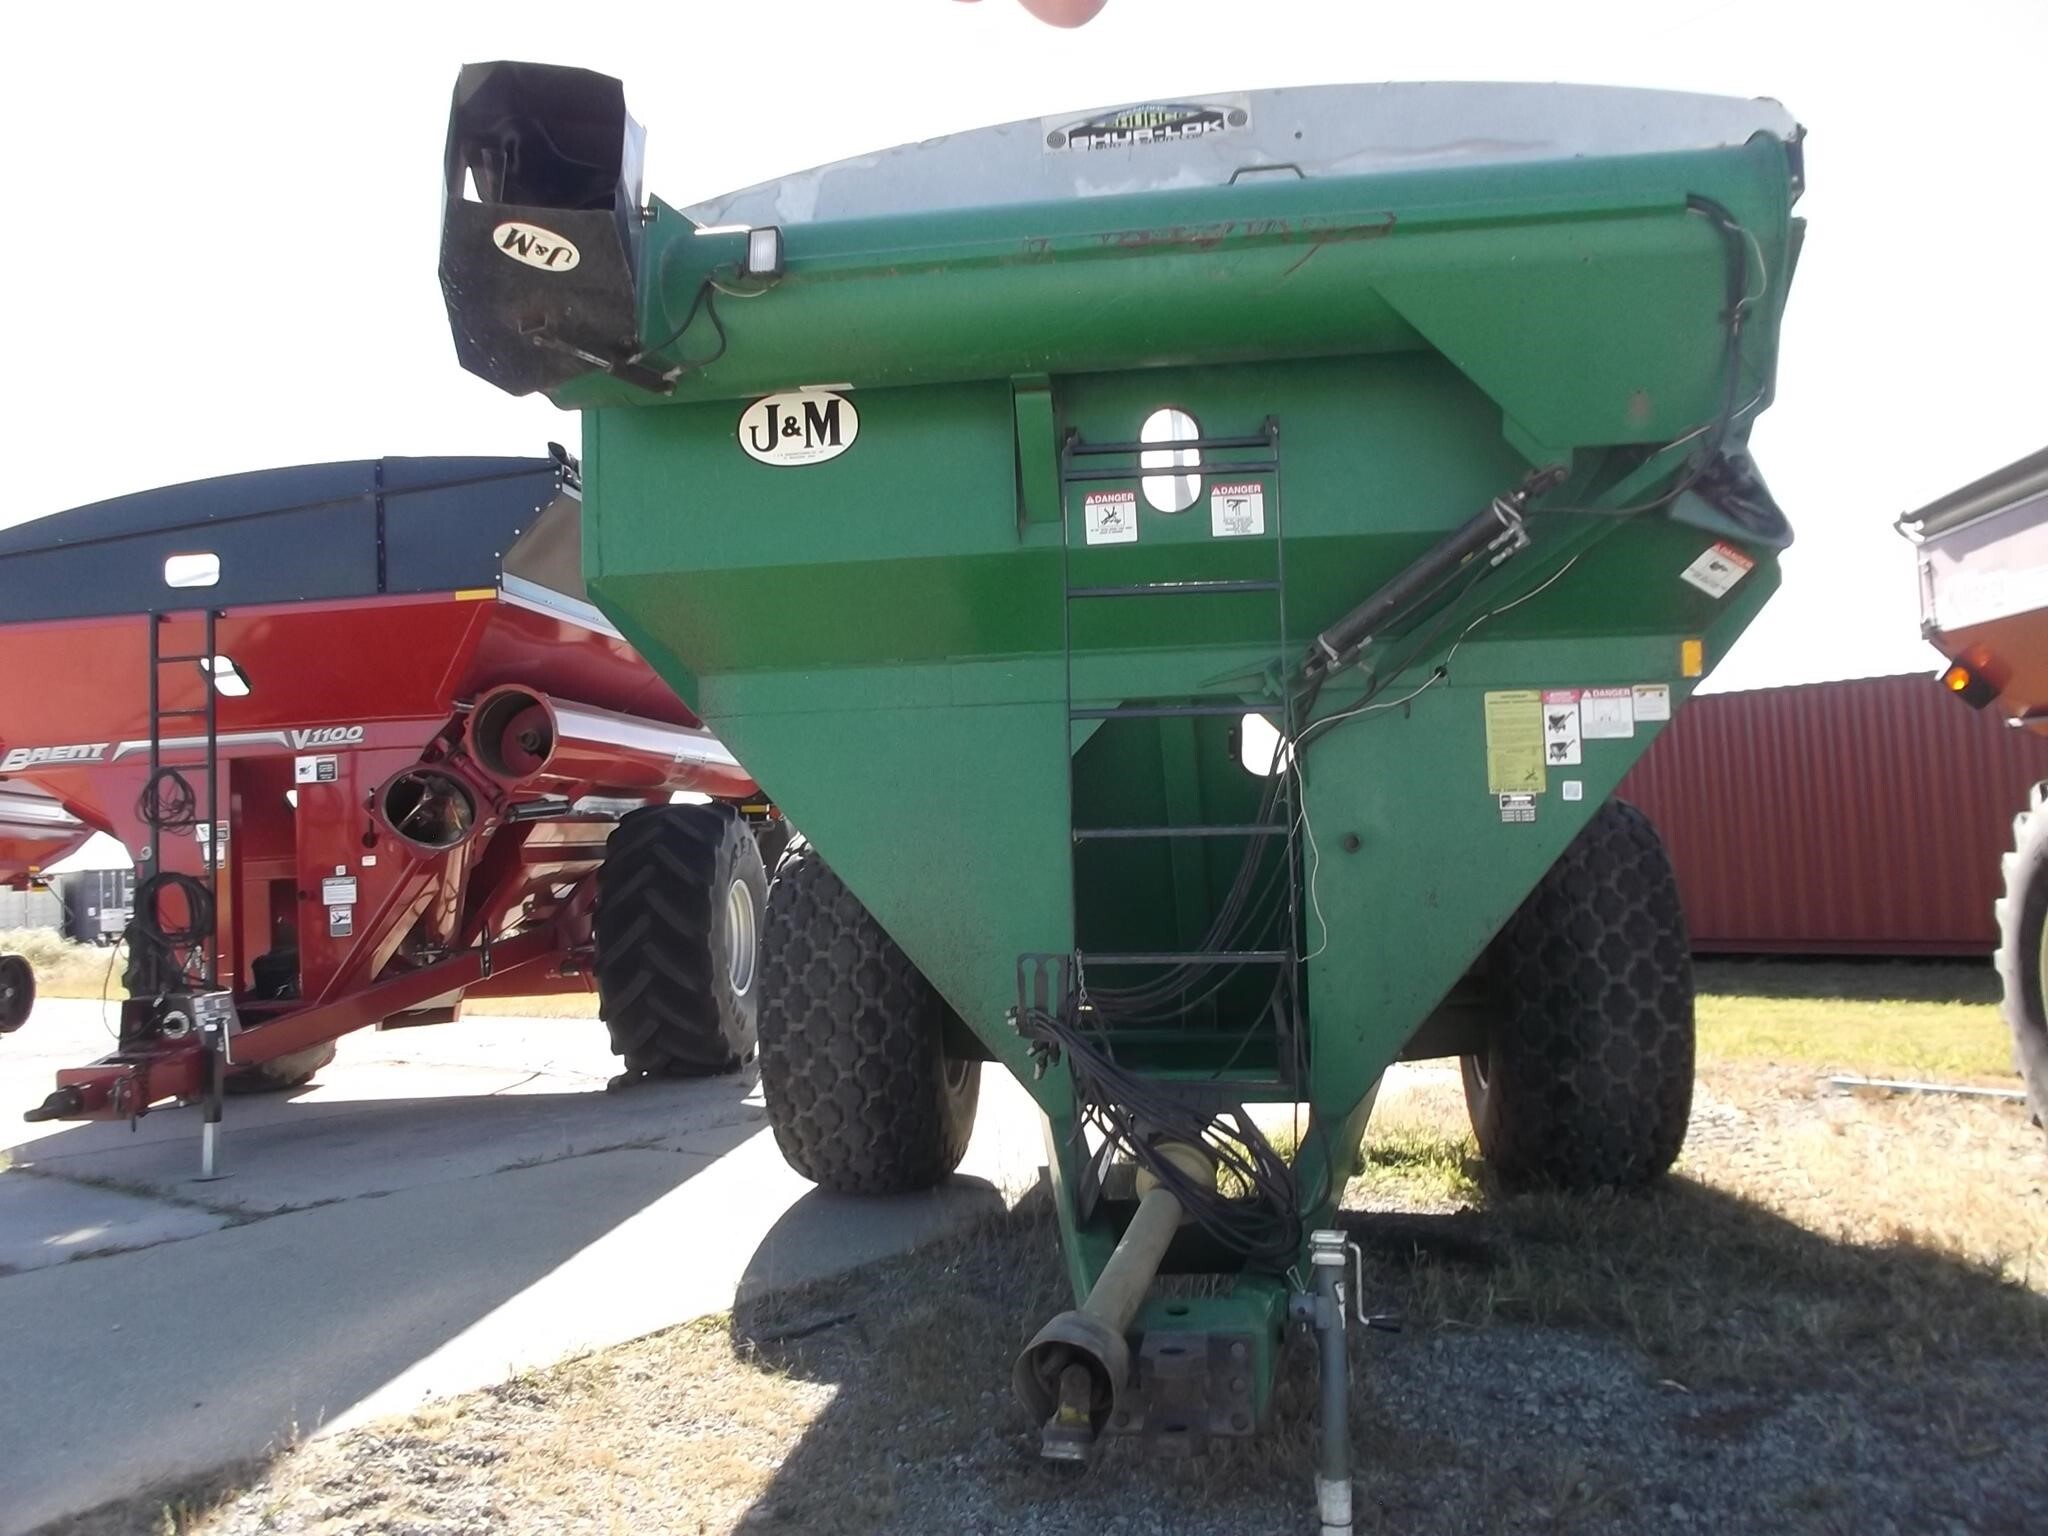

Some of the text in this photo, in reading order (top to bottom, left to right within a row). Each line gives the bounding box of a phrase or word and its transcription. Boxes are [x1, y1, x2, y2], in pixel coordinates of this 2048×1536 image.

[501, 227, 573, 267] J&M
[749, 399, 843, 453] J&M
[1221, 484, 1261, 494] DANGER
[1095, 493, 1134, 504] DANGER
[1592, 688, 1631, 697] DANGER
[291, 726, 363, 750] V1100
